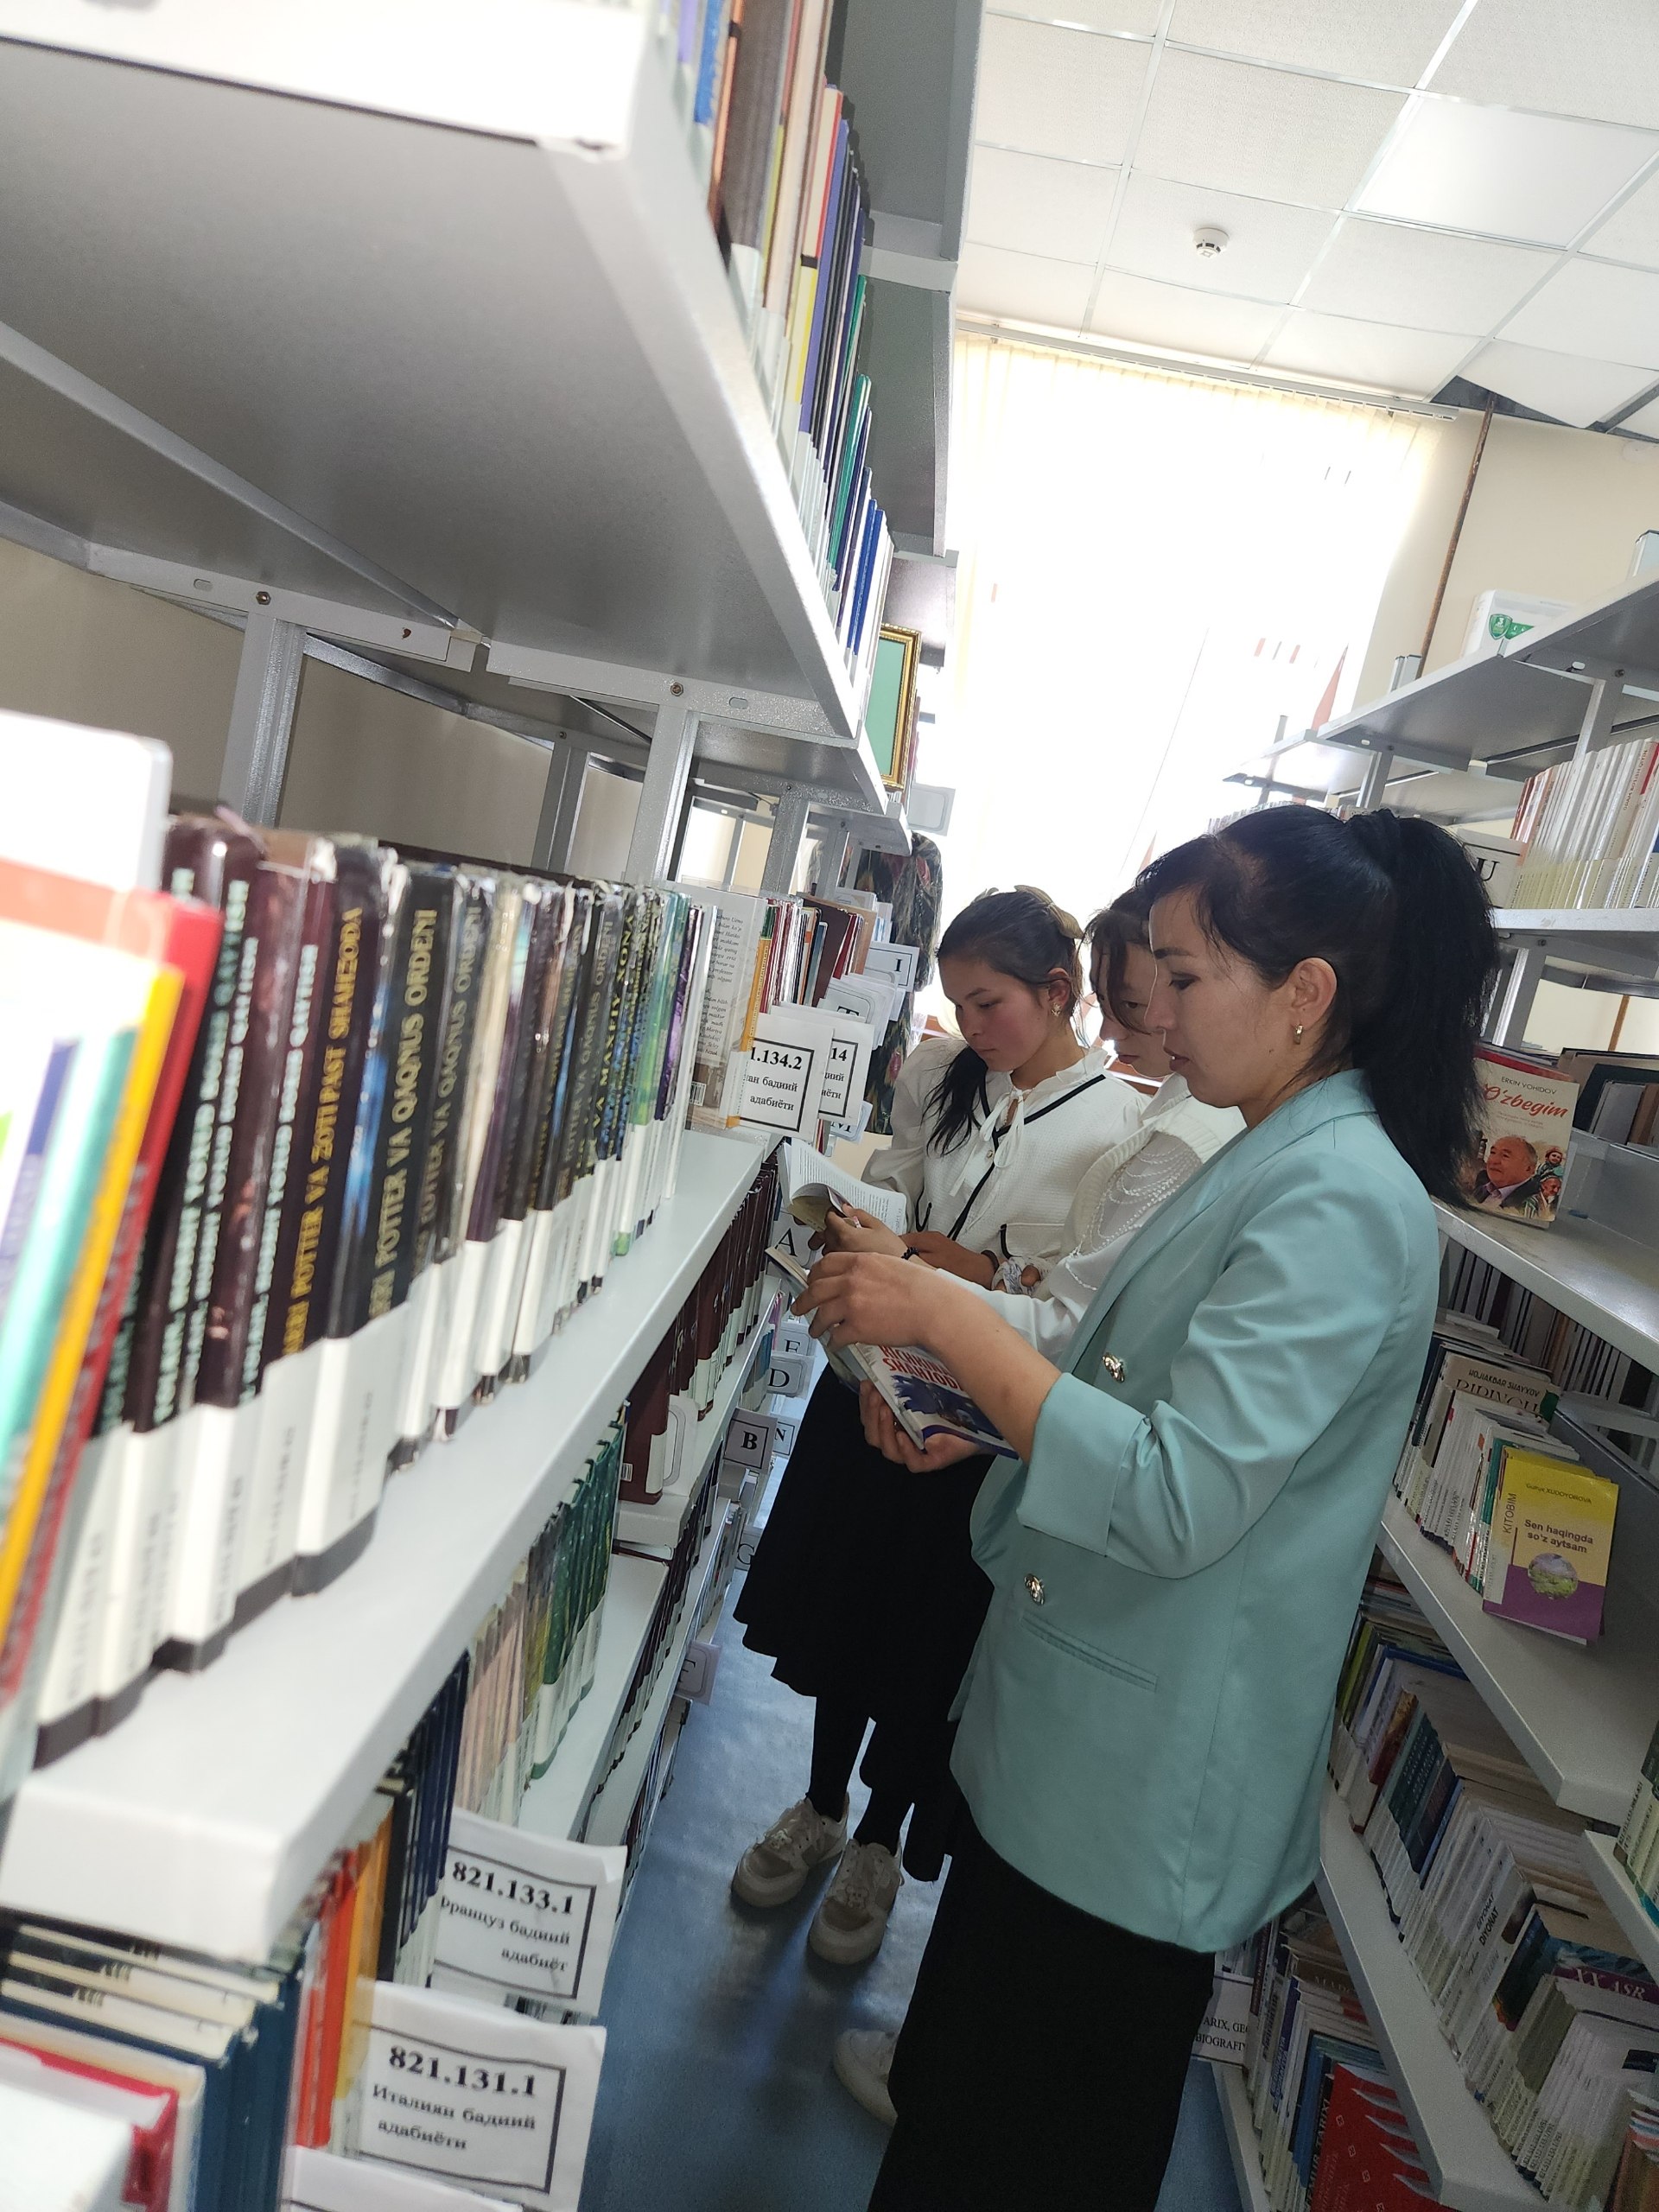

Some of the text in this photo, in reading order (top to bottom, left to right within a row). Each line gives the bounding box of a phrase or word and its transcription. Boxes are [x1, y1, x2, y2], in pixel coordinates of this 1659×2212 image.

[1477, 856, 1501, 881] U
[404, 909, 438, 1007] ORDENI
[454, 905, 482, 994] ORDENI
[328, 906, 364, 1042] SHAHZODA
[437, 999, 467, 1100] QAQNUS
[599, 995, 621, 1088] MAXFIY
[830, 1046, 849, 1062] 14
[391, 1012, 426, 1125] QAQNUS
[762, 1076, 798, 1093] бадиий
[1501, 1076, 1558, 1096] ERKIN VOHIDOV
[432, 1101, 452, 1138] VA
[749, 1094, 795, 1112] адабиёти
[386, 1126, 413, 1169] VA
[304, 1164, 331, 1205] VA
[374, 1168, 409, 1269] POTTER
[290, 1205, 326, 1300] POTTER
[774, 1228, 798, 1258] A
[767, 1367, 791, 1389] D
[882, 1357, 963, 1391] SHAHZOD
[741, 1431, 758, 1451] B
[773, 1427, 786, 1442] N
[1502, 1492, 1517, 1535] KITOBIM
[1524, 1519, 1593, 1545] Sen haqingda
[1550, 1537, 1588, 1554] aytsam
[452, 1860, 574, 1916] 821.133.1
[509, 1919, 571, 1946] бадиий
[1478, 1906, 1500, 1947] DIYONAT
[1609, 1980, 1646, 2001] ASR
[1232, 2022, 1249, 2033] GE
[389, 2044, 536, 2099] 821.131.1
[372, 2083, 537, 2130] Италиян бадиий
[1314, 2097, 1332, 2151] TARIXI
[378, 2119, 467, 2151] адабиёти
